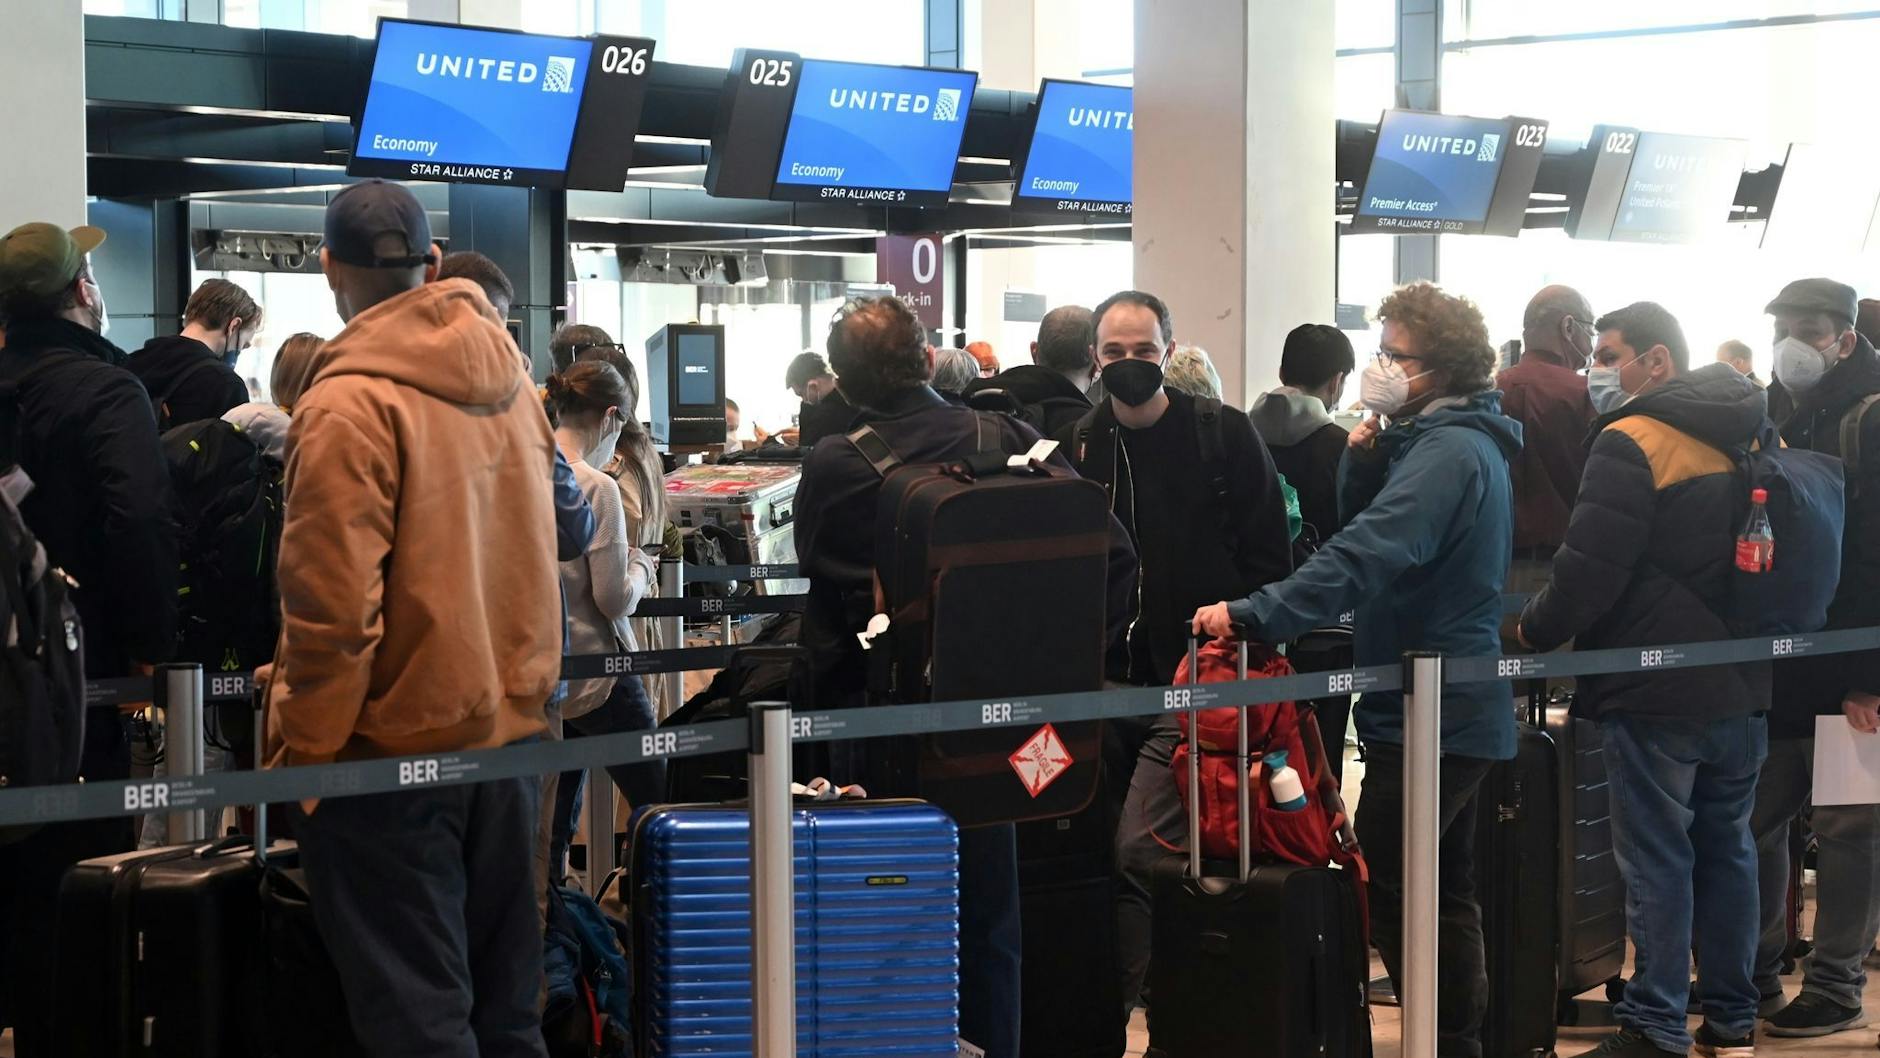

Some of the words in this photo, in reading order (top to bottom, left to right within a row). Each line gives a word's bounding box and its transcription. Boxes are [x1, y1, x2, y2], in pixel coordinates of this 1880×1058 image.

[416, 52, 538, 84] UNITED
[601, 45, 648, 76] 026
[749, 58, 793, 87] 025
[830, 87, 930, 114] UNITED
[1068, 107, 1133, 130] UNIT
[373, 134, 438, 156] Economy
[1402, 134, 1477, 156] UNITED
[1516, 124, 1546, 147] 023
[1606, 131, 1635, 154] 022
[410, 163, 440, 176] STAR
[441, 165, 500, 180] ALLIANCE
[791, 162, 845, 181] Economy
[1654, 153, 1708, 174] UNIT
[820, 188, 846, 198] STAR
[847, 189, 895, 201] ALLIANCE
[1032, 177, 1079, 194] Economy
[1057, 200, 1080, 211] STAR
[1081, 202, 1123, 213] ALLIANCE
[1370, 197, 1404, 211] Premier
[1378, 217, 1397, 227] STAR
[1398, 219, 1432, 229] ALLIANCE
[1444, 221, 1464, 231] GOLD
[912, 238, 937, 284] 0
[897, 291, 932, 307] ck-in
[750, 566, 769, 578] BER
[701, 599, 723, 613] BER
[1773, 638, 1793, 655] BER
[605, 656, 633, 674] BER
[1498, 659, 1521, 677] BER
[1641, 650, 1663, 667] BER
[211, 676, 244, 696] BER
[1329, 673, 1353, 693] BER
[1164, 689, 1191, 709] BER
[982, 703, 1012, 724] BER
[792, 716, 812, 738] ER
[641, 731, 677, 757] BER
[1029, 742, 1055, 778] FRAGILE
[399, 759, 439, 785] BER
[124, 783, 169, 810] BER
